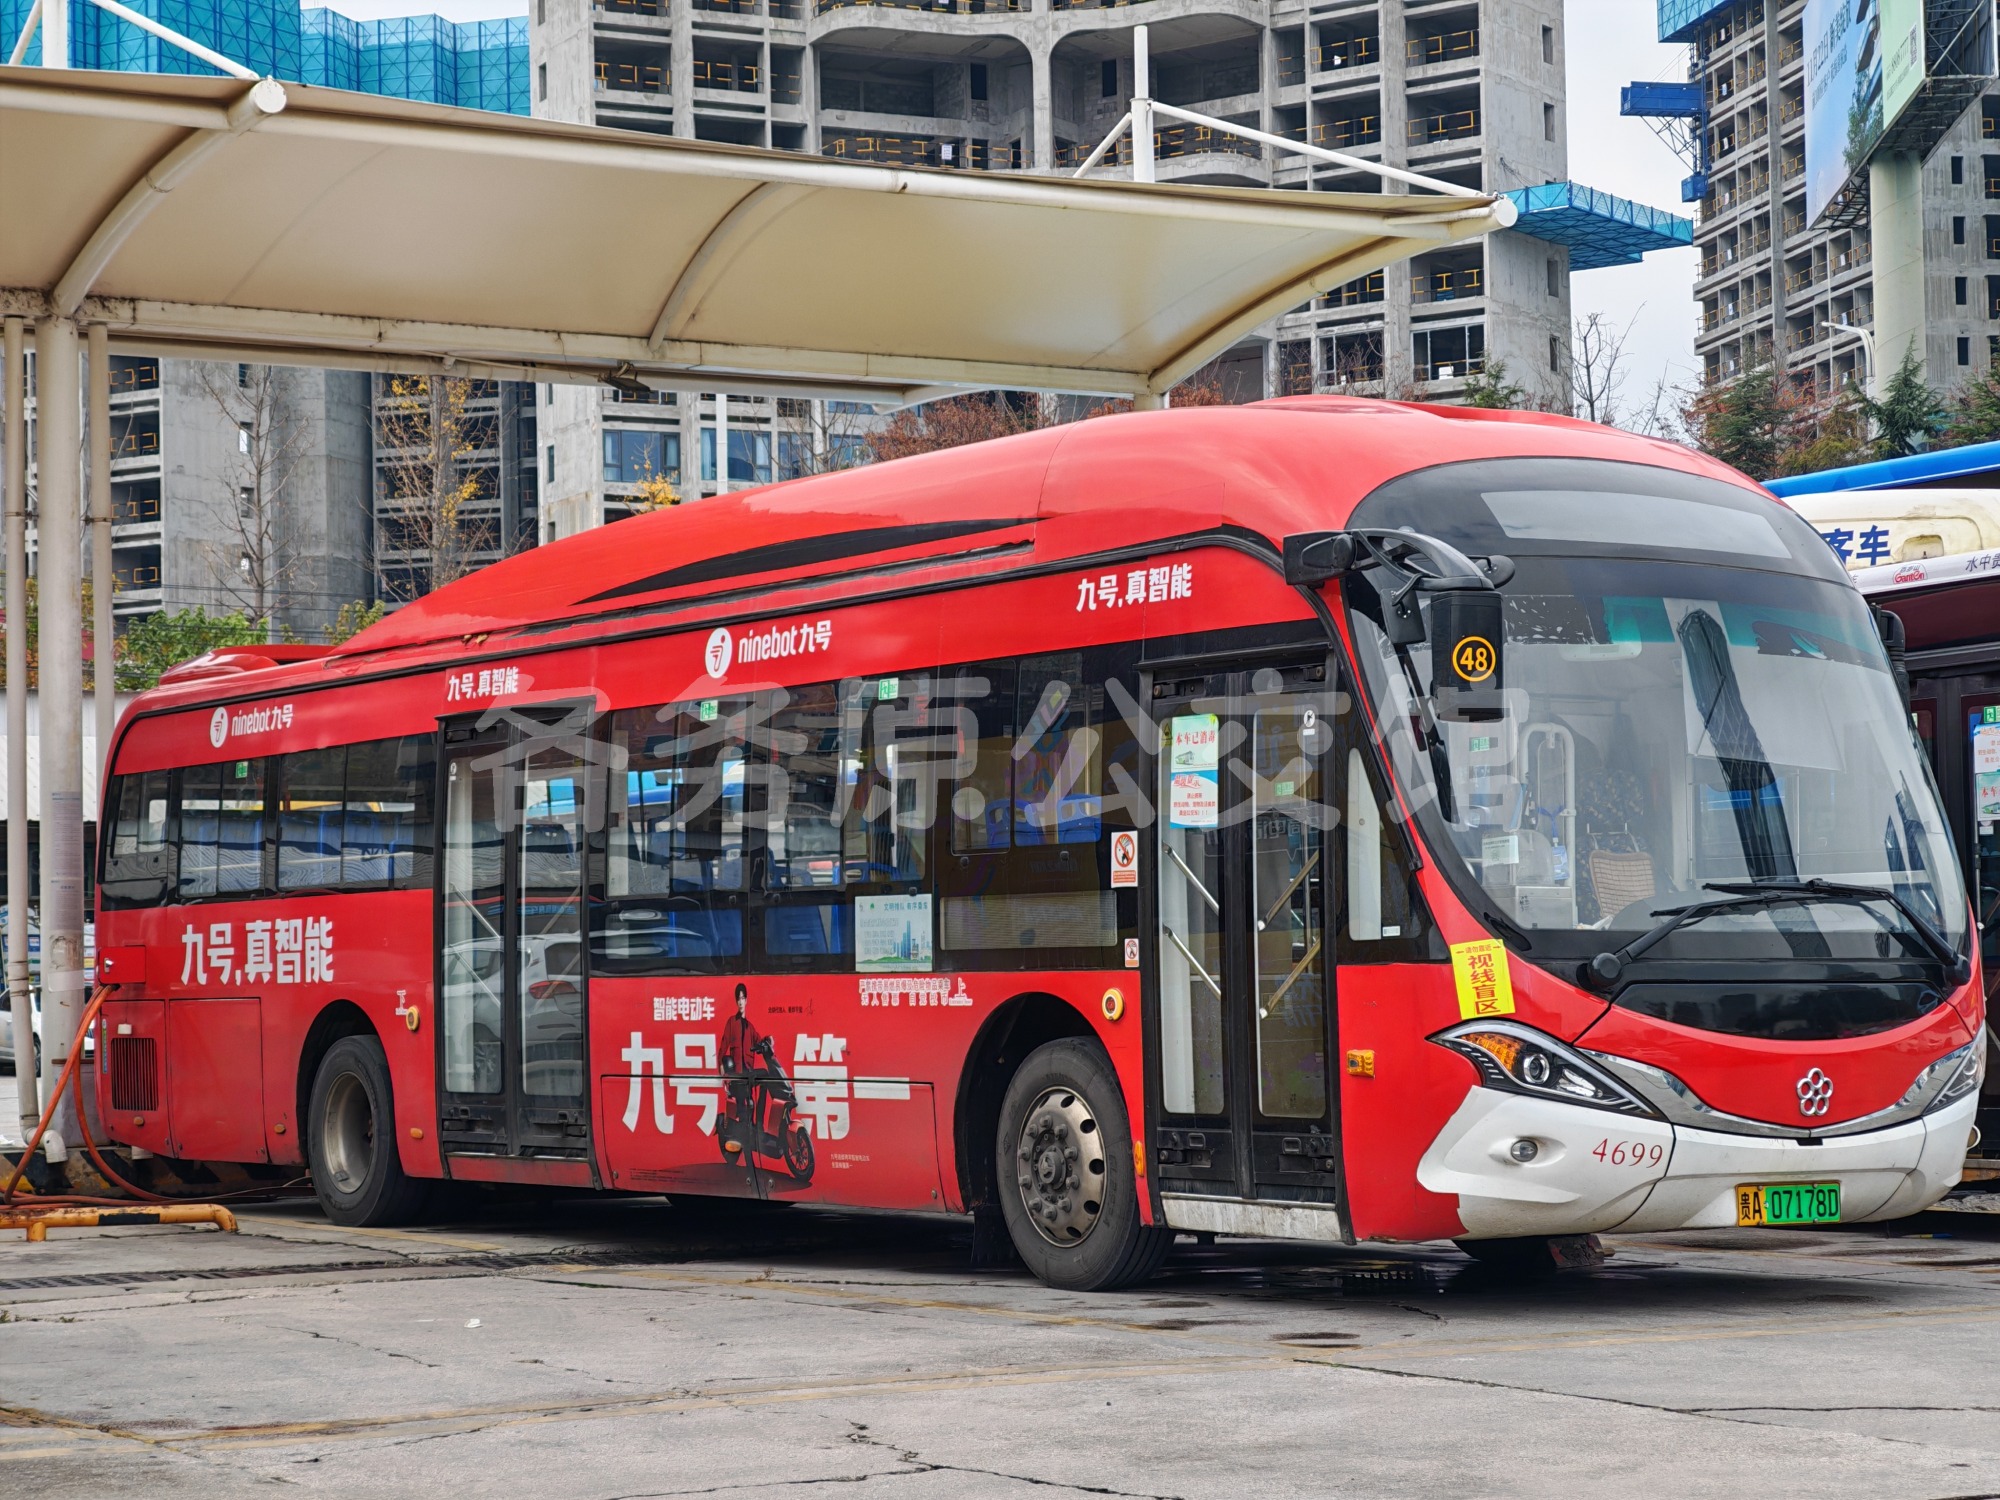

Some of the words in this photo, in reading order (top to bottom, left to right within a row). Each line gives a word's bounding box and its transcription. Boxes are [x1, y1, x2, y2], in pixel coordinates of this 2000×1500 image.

[1821, 524, 1891, 566] 客车
[1460, 647, 1488, 671] 48
[1175, 730, 1216, 746] 本车已消毒
[1468, 953, 1501, 1015] 视线盲区
[653, 996, 716, 1021] 智能电动车
[1592, 1138, 1664, 1168] 4699
